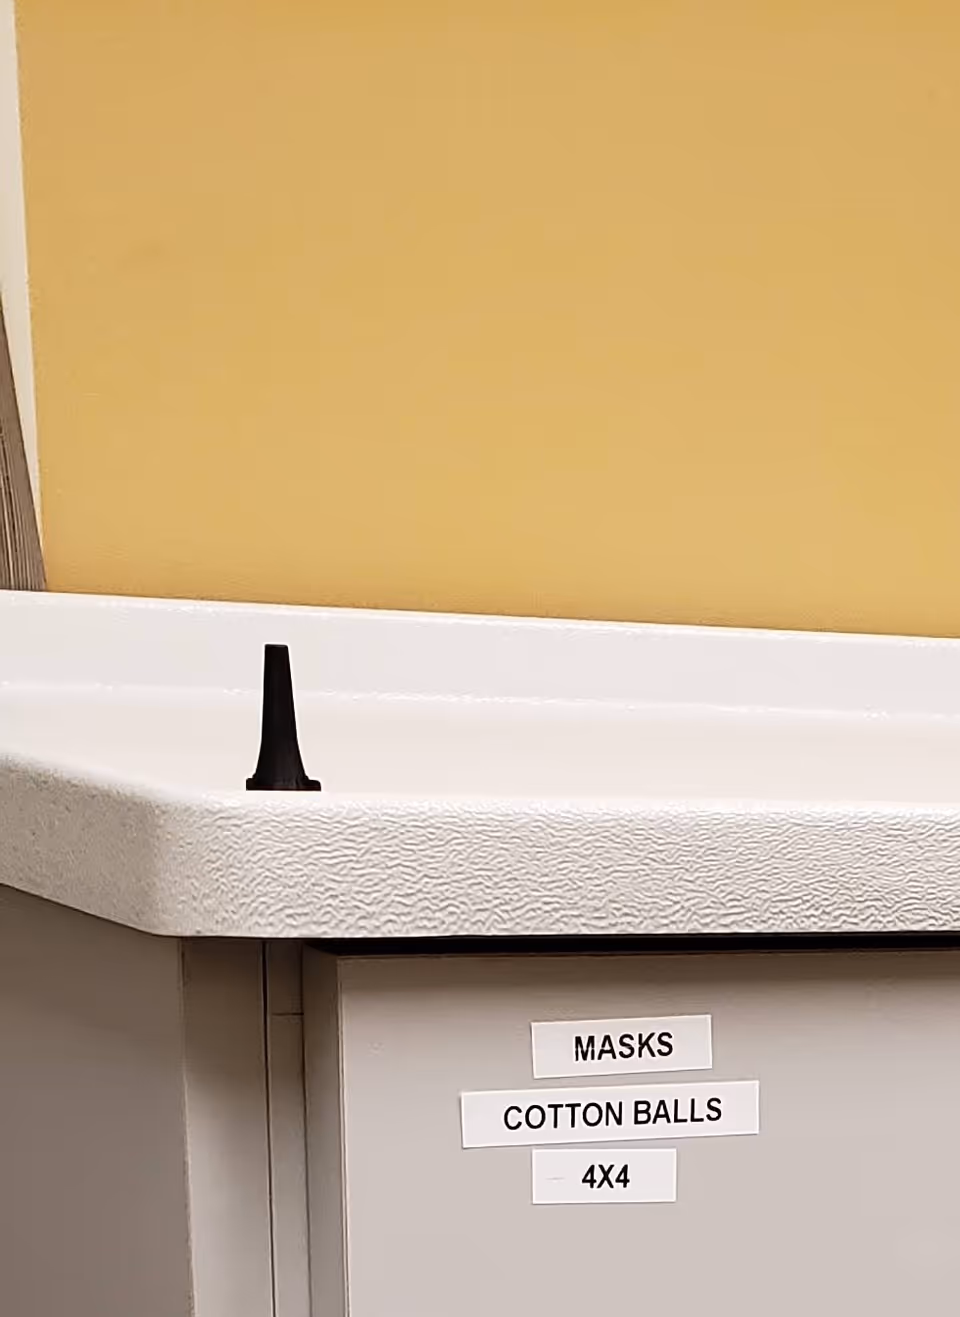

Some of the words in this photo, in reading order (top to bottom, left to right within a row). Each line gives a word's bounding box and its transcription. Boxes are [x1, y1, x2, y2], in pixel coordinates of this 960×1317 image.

[573, 1030, 674, 1062] MASKS
[503, 1101, 624, 1131] COTTON
[633, 1096, 723, 1126] BALLS
[580, 1163, 631, 1190] 4X4
